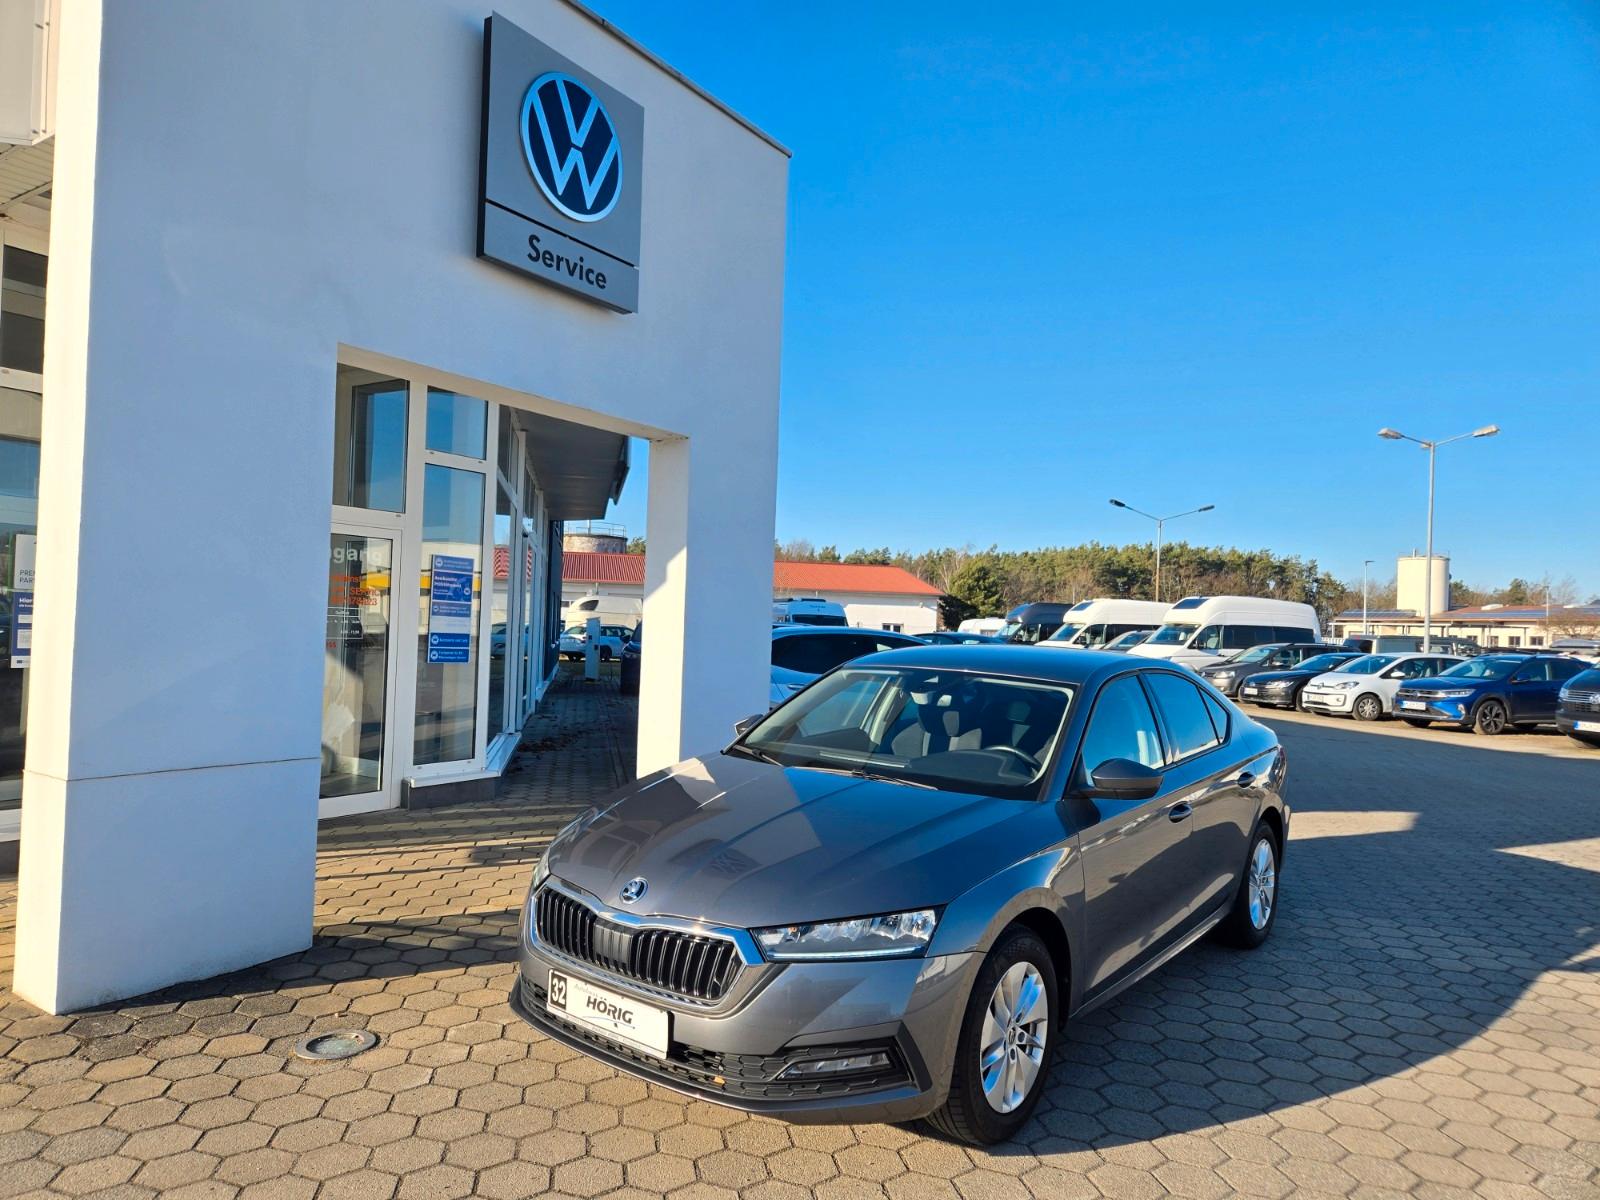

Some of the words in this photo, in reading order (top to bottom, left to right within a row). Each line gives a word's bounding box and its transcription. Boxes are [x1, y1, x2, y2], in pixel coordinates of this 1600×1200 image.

[527, 234, 608, 290] Service
[19, 569, 36, 577] PRE
[551, 977, 566, 1005] 32
[586, 996, 634, 1024] HÖRIG
